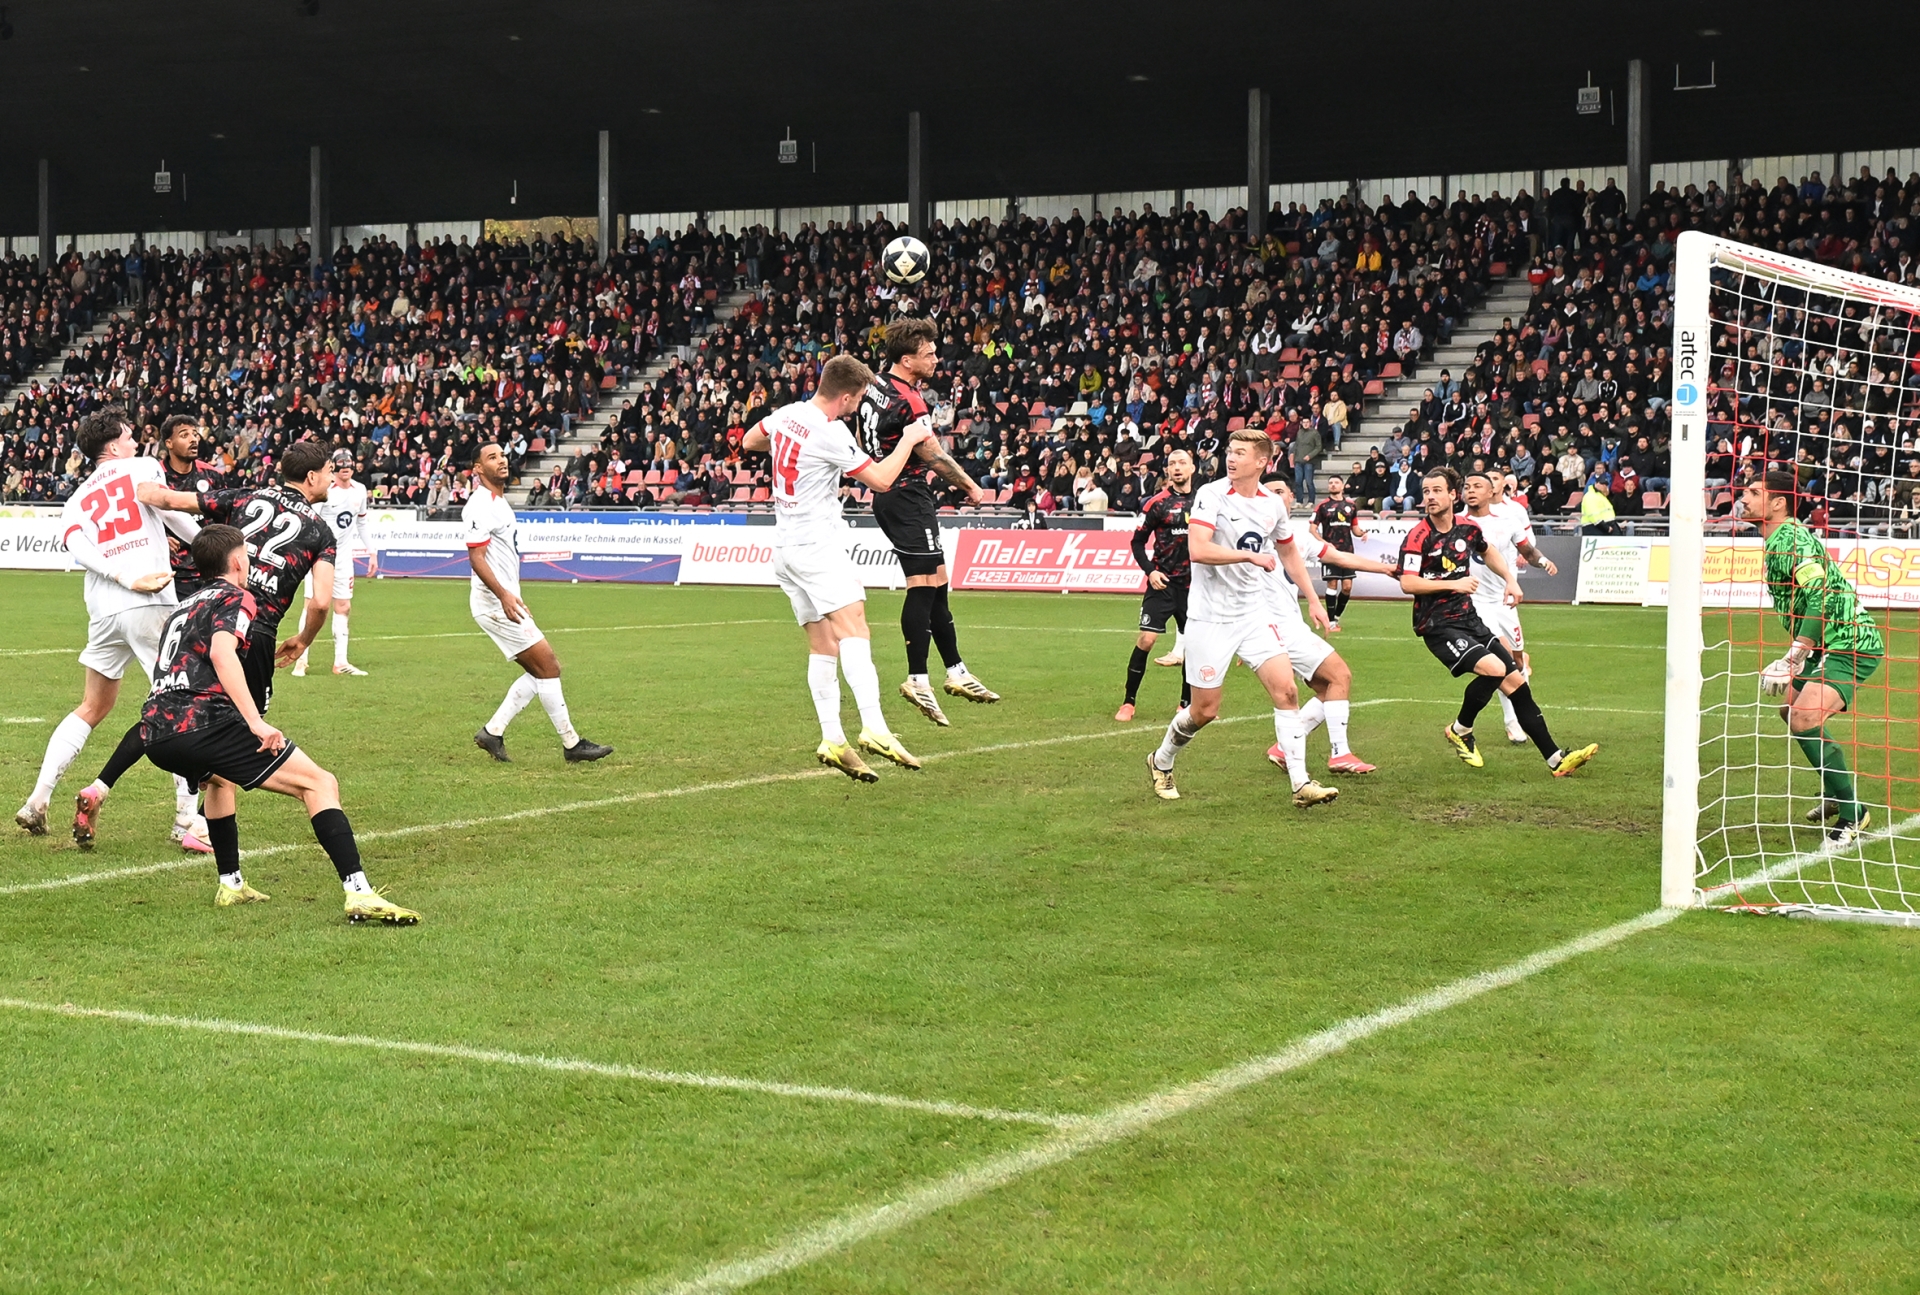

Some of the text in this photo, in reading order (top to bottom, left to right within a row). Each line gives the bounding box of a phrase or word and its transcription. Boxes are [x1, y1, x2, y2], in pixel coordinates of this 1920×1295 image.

[1680, 330, 1698, 380] artec
[773, 430, 801, 496] 14
[80, 473, 143, 544] 23
[238, 499, 302, 570] 22
[584, 534, 616, 543] Technik
[617, 535, 641, 543] made
[643, 536, 651, 544] in
[972, 540, 1054, 565] Maler
[1703, 556, 1758, 564] Wir helfen
[969, 571, 1011, 581] 34233
[1011, 571, 1060, 583] Fuldatal
[1104, 573, 1121, 584] 63
[1726, 567, 1746, 575] und
[158, 612, 189, 672] 6
[1513, 625, 1521, 642] 3
